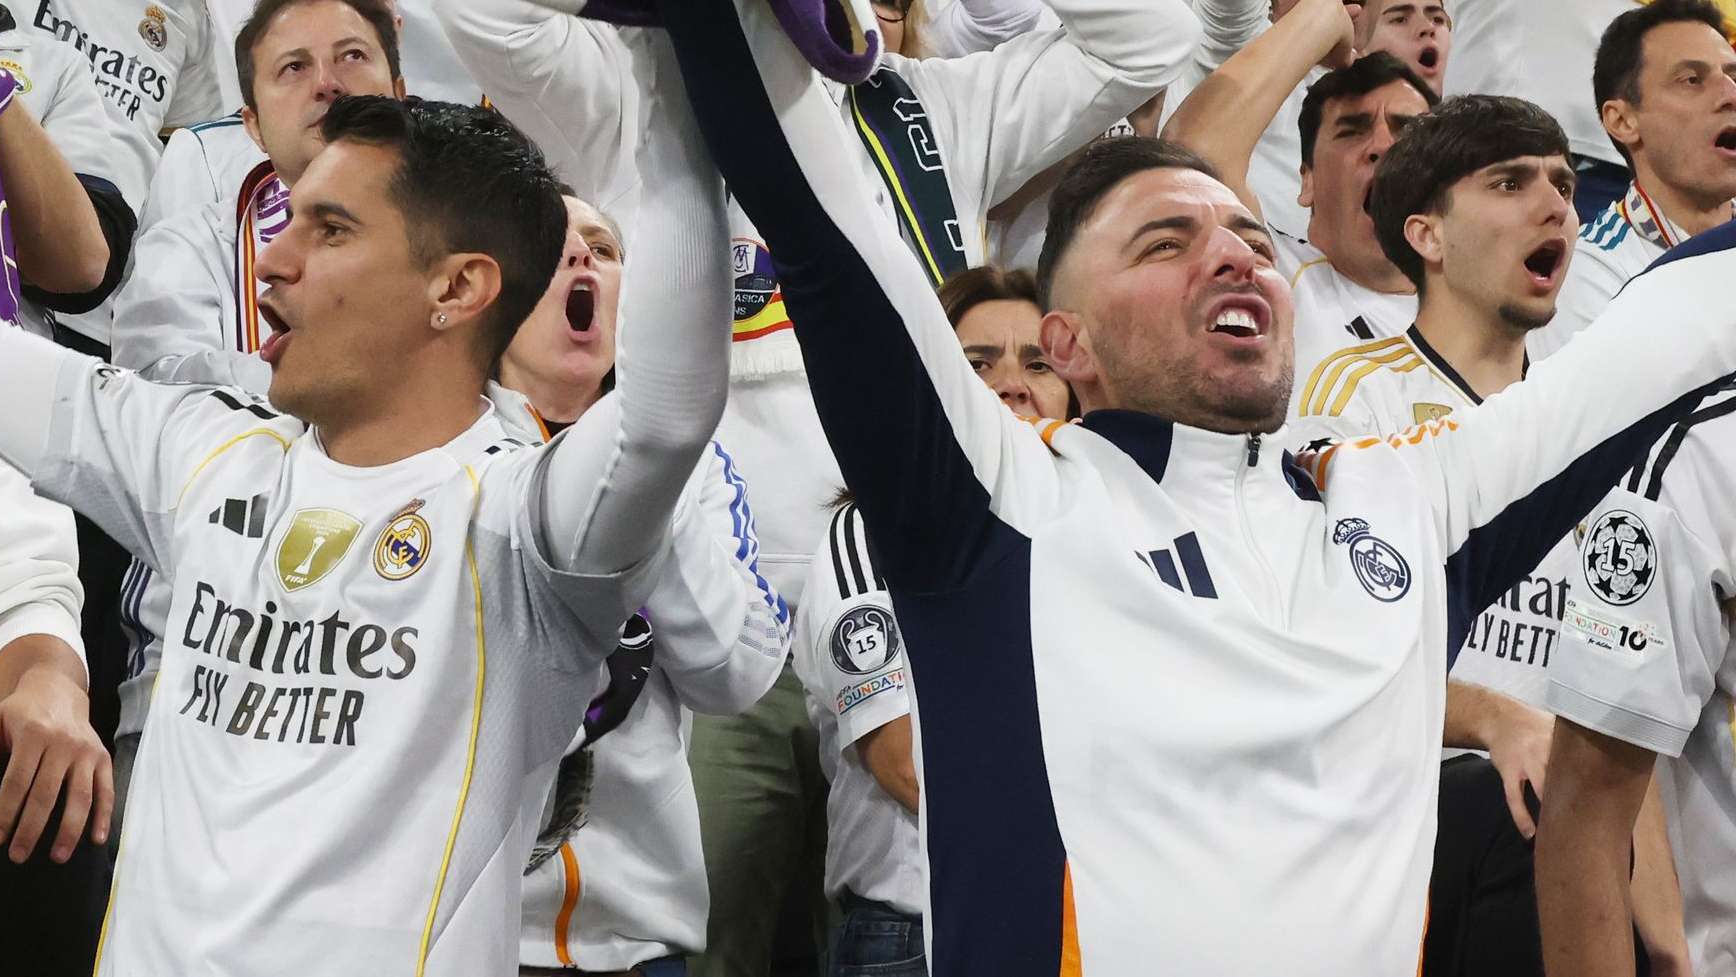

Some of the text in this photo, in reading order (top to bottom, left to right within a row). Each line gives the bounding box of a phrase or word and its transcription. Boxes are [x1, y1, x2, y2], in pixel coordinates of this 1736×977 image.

[735, 294, 765, 304] ASICA
[1600, 536, 1637, 576] 15
[182, 580, 419, 680] Emirates
[856, 634, 877, 655] 15
[1467, 612, 1562, 668] LY BETT
[179, 664, 365, 747] FLY BETTER
[838, 671, 904, 713] FOUNDATI
